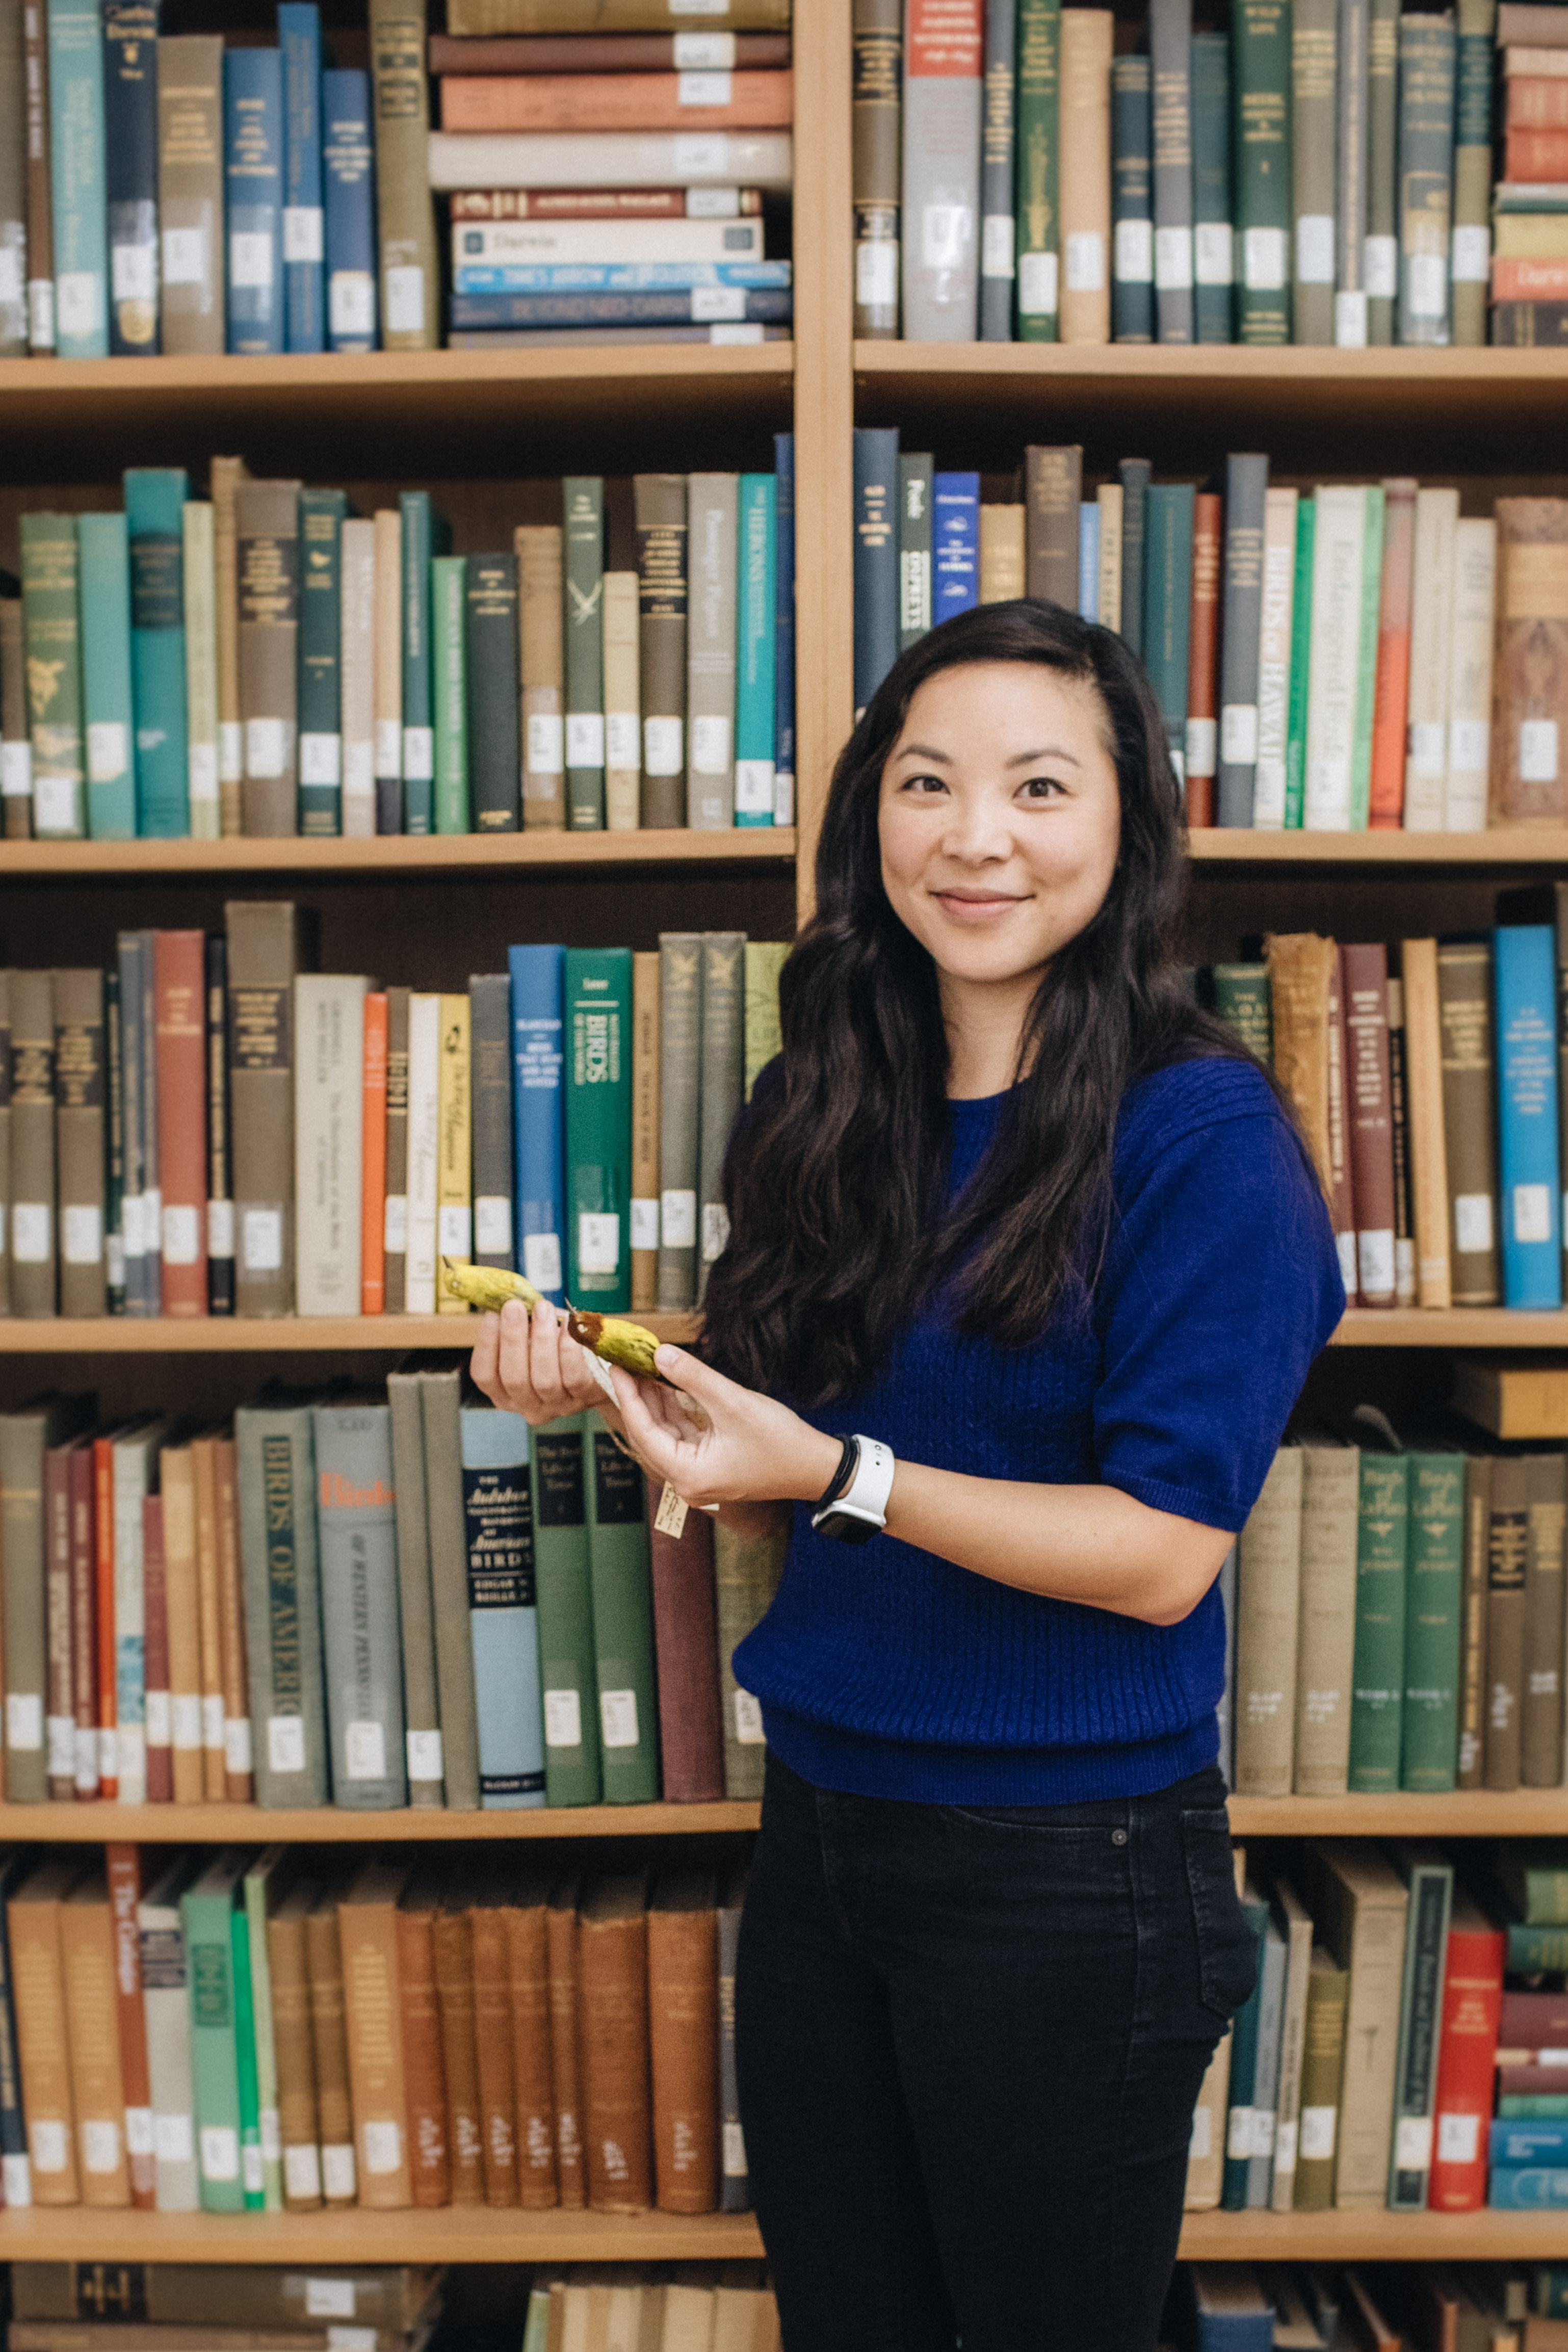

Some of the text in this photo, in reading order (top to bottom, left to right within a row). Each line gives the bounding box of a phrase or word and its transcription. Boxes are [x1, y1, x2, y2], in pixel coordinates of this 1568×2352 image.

[587, 1014, 607, 1083] BIRDS
[320, 1472, 396, 1507] Birds
[467, 1486, 529, 1505] Audubon
[470, 1533, 531, 1551] American
[266, 1440, 302, 1717] BIRDS OF AMERIC
